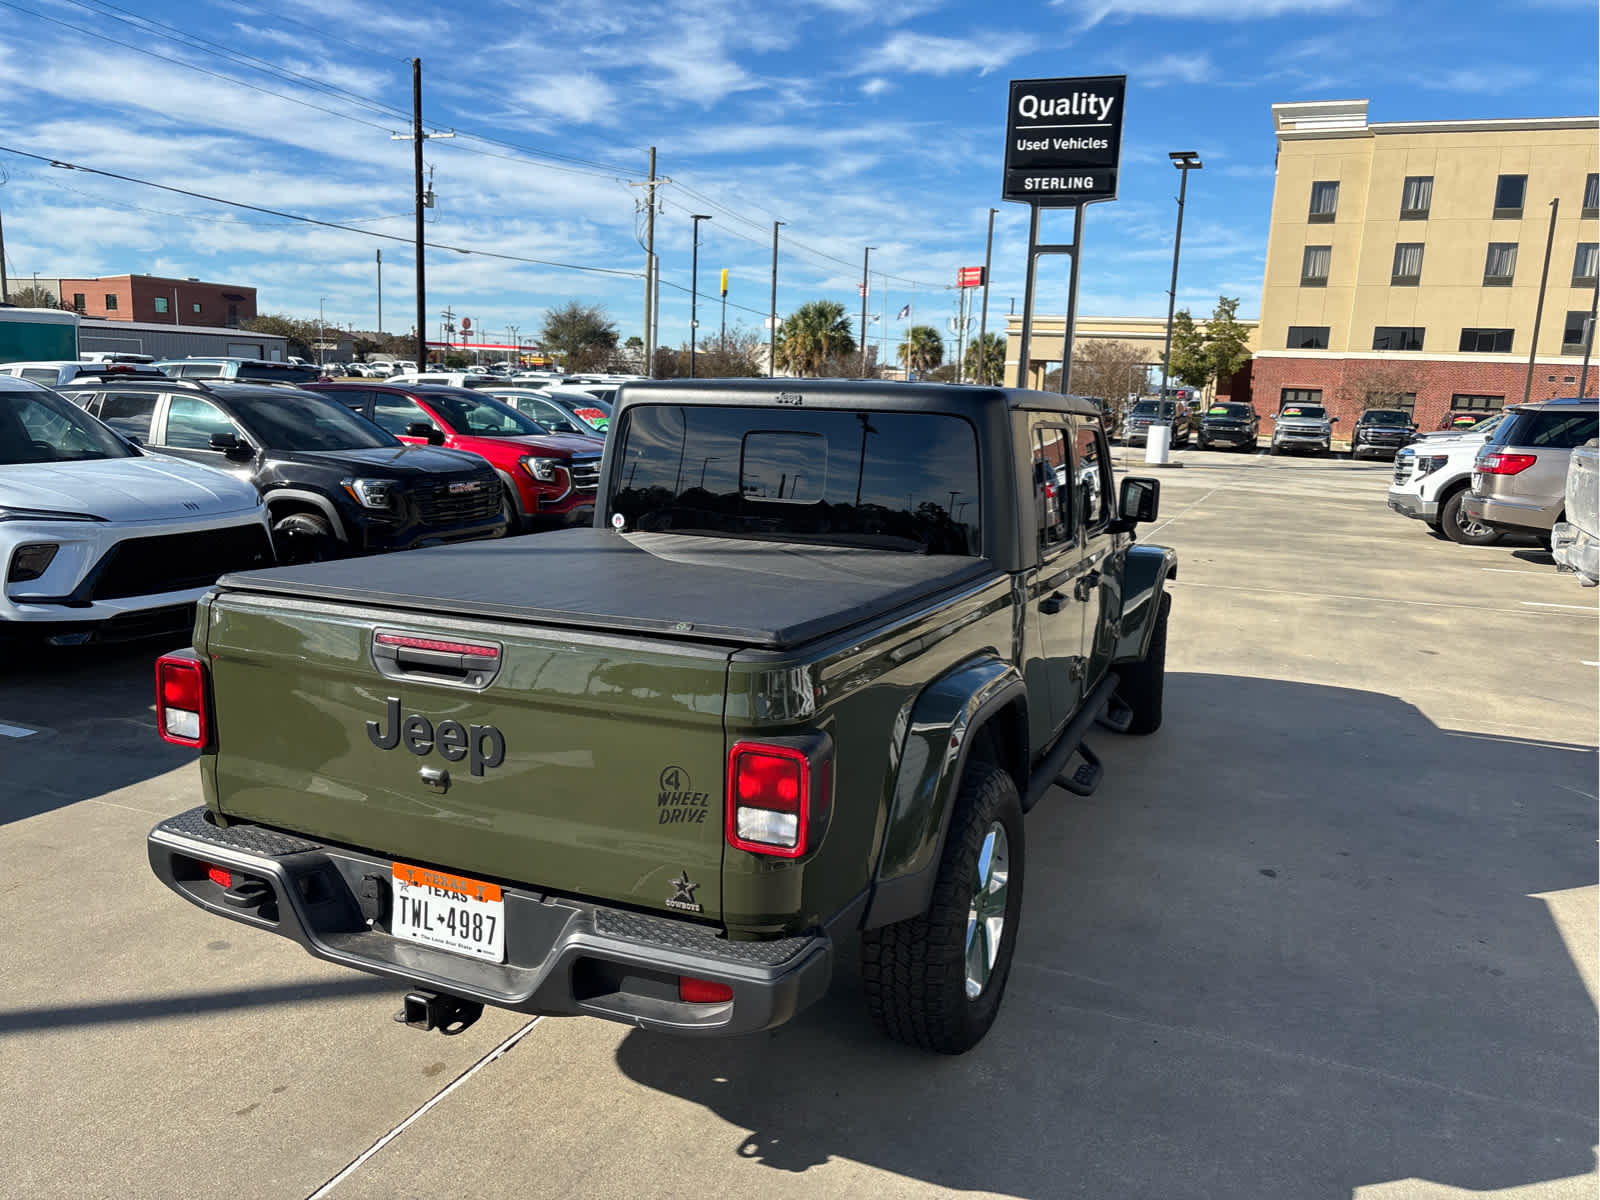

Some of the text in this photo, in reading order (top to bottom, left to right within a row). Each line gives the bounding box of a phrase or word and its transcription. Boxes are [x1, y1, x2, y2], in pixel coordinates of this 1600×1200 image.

[1018, 92, 1114, 120] Quality
[1017, 137, 1108, 150] Used Vehicles
[1024, 176, 1094, 190] STERLING
[366, 696, 506, 777] Jeep
[665, 770, 680, 790] 4
[658, 791, 709, 807] WHEEL
[659, 807, 709, 824] DRIVE
[423, 871, 467, 892] TEXAS
[427, 885, 468, 903] TEXAS
[400, 896, 497, 946] TWL 4987
